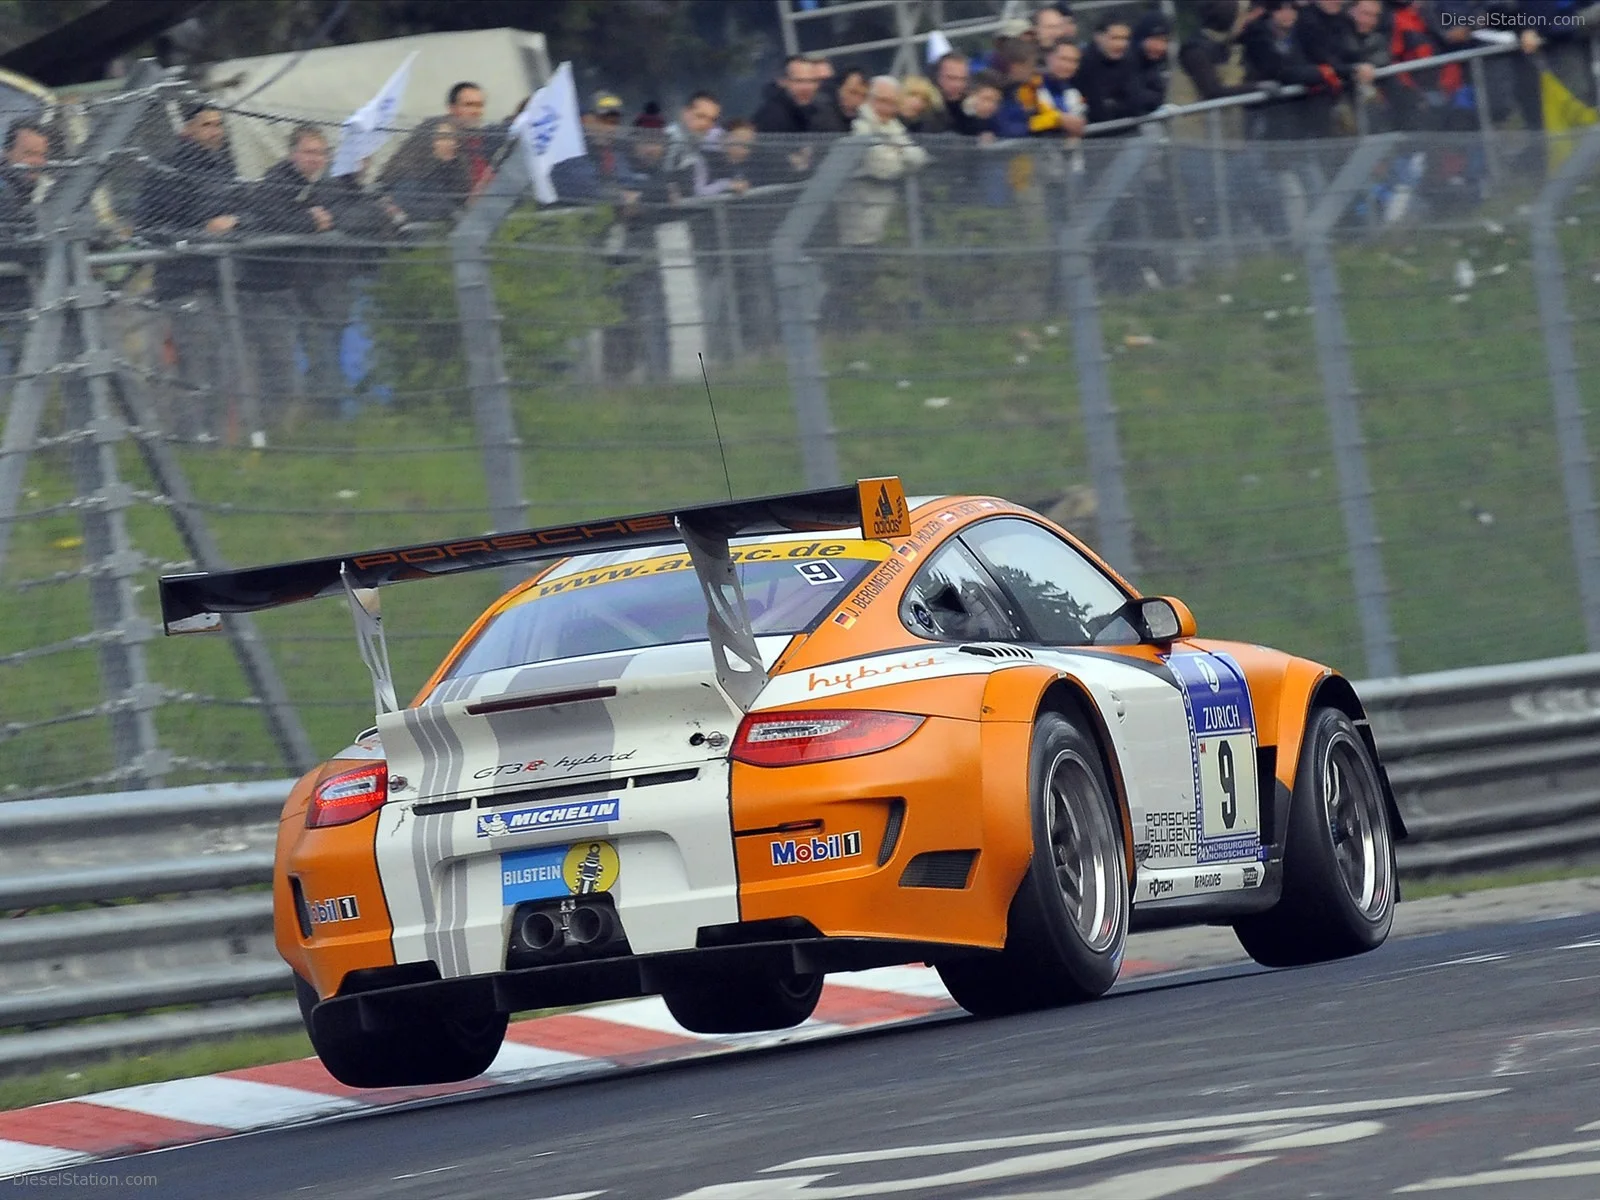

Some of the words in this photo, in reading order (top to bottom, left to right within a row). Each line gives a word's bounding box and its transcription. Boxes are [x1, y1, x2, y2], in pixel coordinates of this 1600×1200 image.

[353, 515, 675, 571] PORSCHE
[540, 543, 847, 597] www.ac.de
[800, 561, 837, 582] 9
[852, 557, 905, 610] BERGMEISTER
[808, 657, 944, 692] hybrid
[1202, 703, 1241, 730] ZURICH
[552, 749, 638, 772] hybrid
[1217, 739, 1237, 829] 9
[509, 801, 617, 828] MICHELIN
[1146, 811, 1197, 827] PORSCHE
[771, 835, 841, 866] Mobil
[503, 864, 561, 886] BILSTEIN
